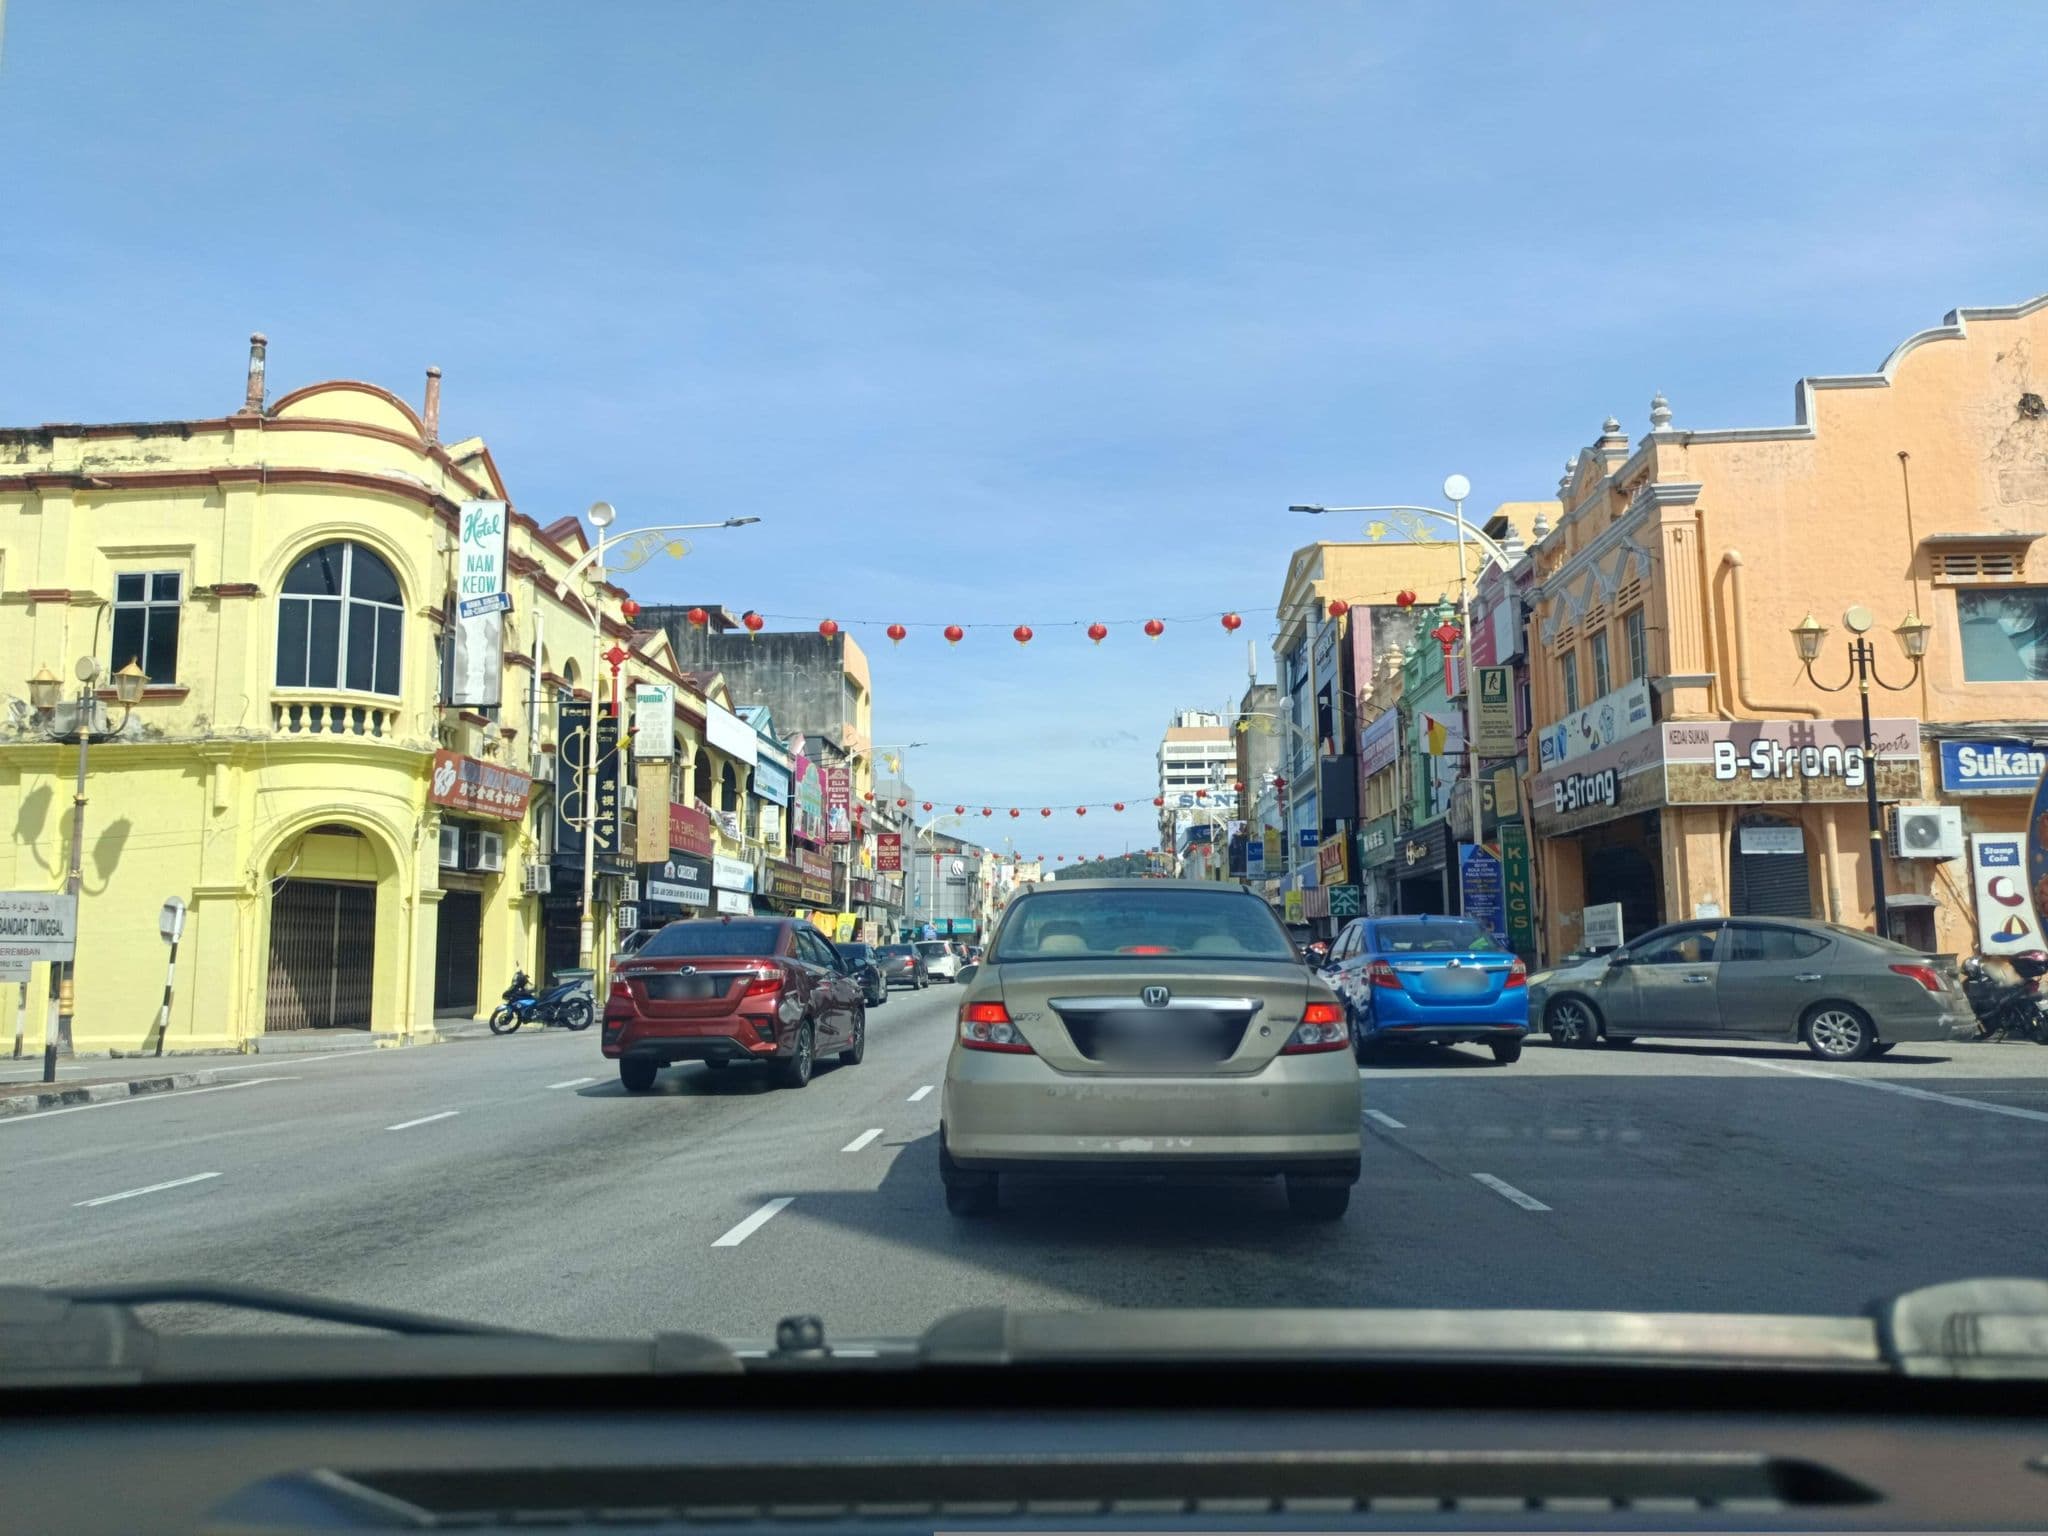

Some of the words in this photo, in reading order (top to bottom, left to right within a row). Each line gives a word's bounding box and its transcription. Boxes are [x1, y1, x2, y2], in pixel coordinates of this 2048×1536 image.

[463, 507, 501, 549] Hotel
[467, 554, 494, 572] NAM
[462, 575, 496, 593] KEOW
[637, 694, 663, 703] PUMA
[1669, 729, 1687, 745] KEDAI
[1688, 729, 1710, 745] SUKAN
[1712, 738, 1867, 788] B-Strong
[1958, 746, 2046, 777] Sukan
[1553, 769, 1616, 813] B-Strong
[1984, 847, 2014, 855] Stamp
[1988, 854, 2009, 862] Coin
[1507, 847, 1529, 929] KINGS
[30, 918, 64, 936] TUNGGAL
